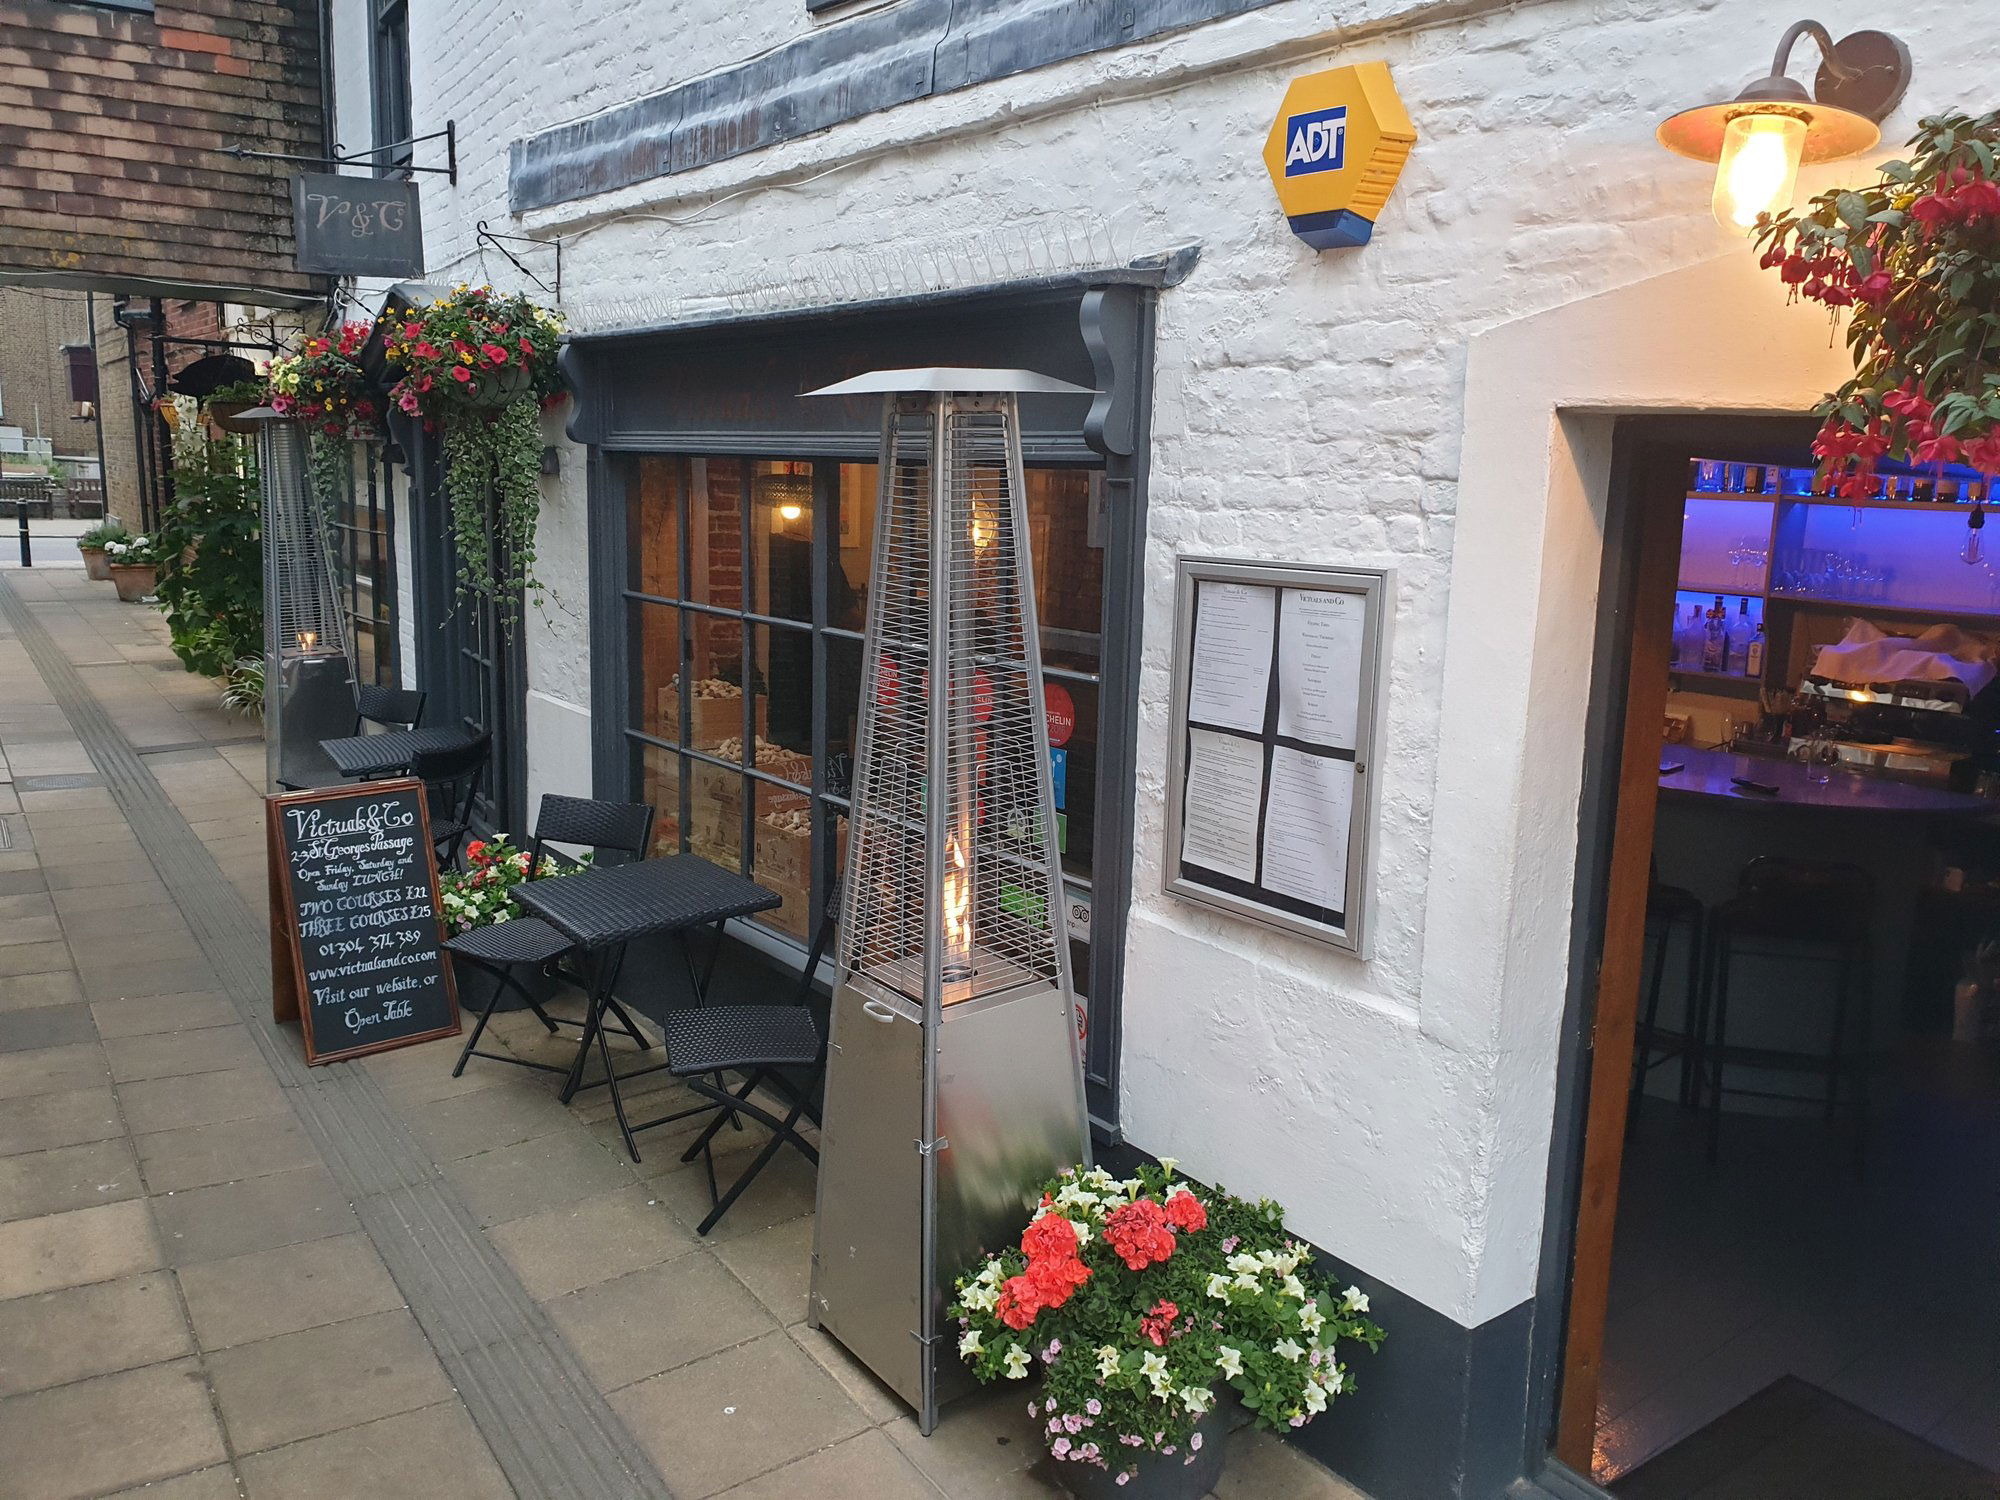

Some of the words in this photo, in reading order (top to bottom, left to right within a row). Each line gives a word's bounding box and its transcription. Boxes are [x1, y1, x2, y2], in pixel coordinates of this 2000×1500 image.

[1286, 117, 1346, 166] ADT
[1046, 713, 1071, 727] CHELIN
[370, 832, 414, 855] Passage
[296, 868, 321, 881] Open
[356, 857, 396, 871] Saturday
[398, 853, 414, 865] and
[300, 899, 333, 917] TWO
[336, 888, 401, 909] COURSES
[405, 885, 428, 900] £22
[315, 878, 349, 893] Sunday
[299, 915, 346, 938] THREE
[349, 906, 409, 929] COURSES
[409, 905, 431, 920] £25
[319, 938, 365, 960] 01304
[368, 932, 395, 953] 374
[396, 930, 421, 949] 389
[309, 950, 437, 981] www.victualsandco.com
[313, 986, 346, 1006] Visit
[348, 986, 371, 999] our
[423, 974, 438, 985] or
[344, 1007, 381, 1034] Open
[382, 1000, 413, 1020] Table
